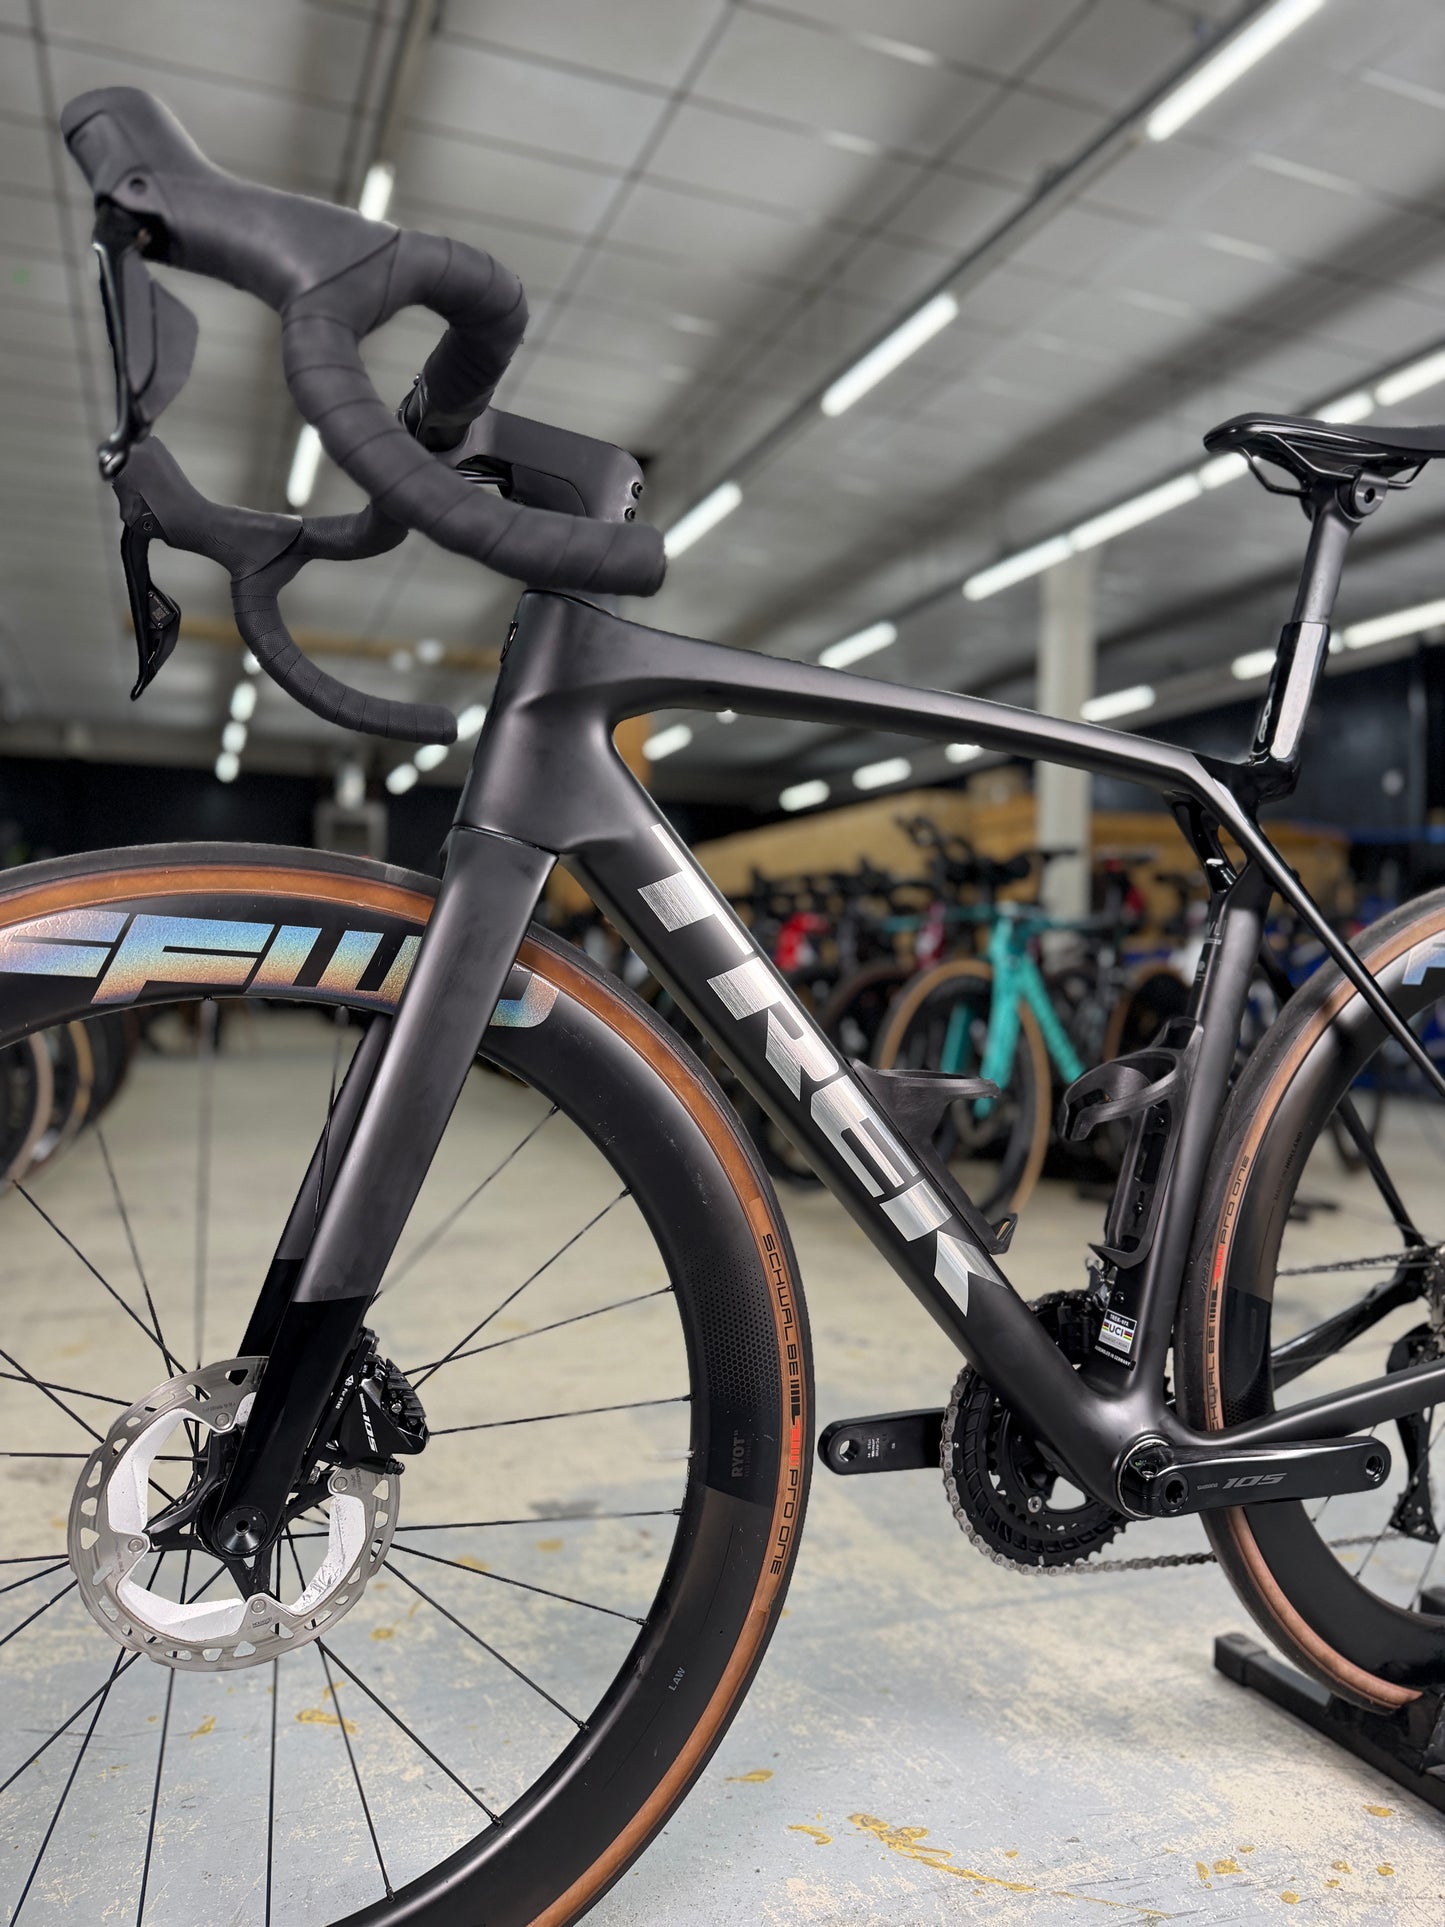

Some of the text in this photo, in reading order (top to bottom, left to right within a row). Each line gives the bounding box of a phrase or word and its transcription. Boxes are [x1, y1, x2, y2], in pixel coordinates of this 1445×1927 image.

[0, 909, 561, 1028] FFW
[637, 824, 1009, 1317] TREK
[762, 1233, 799, 1376] SCHWALBE
[1108, 1323, 1124, 1337] UCI
[1208, 1325, 1220, 1432] CHWALBE
[362, 1414, 379, 1453] 105
[783, 1469, 799, 1519] PRO
[1222, 1472, 1288, 1489] 105
[668, 1666, 686, 1691] LAW
